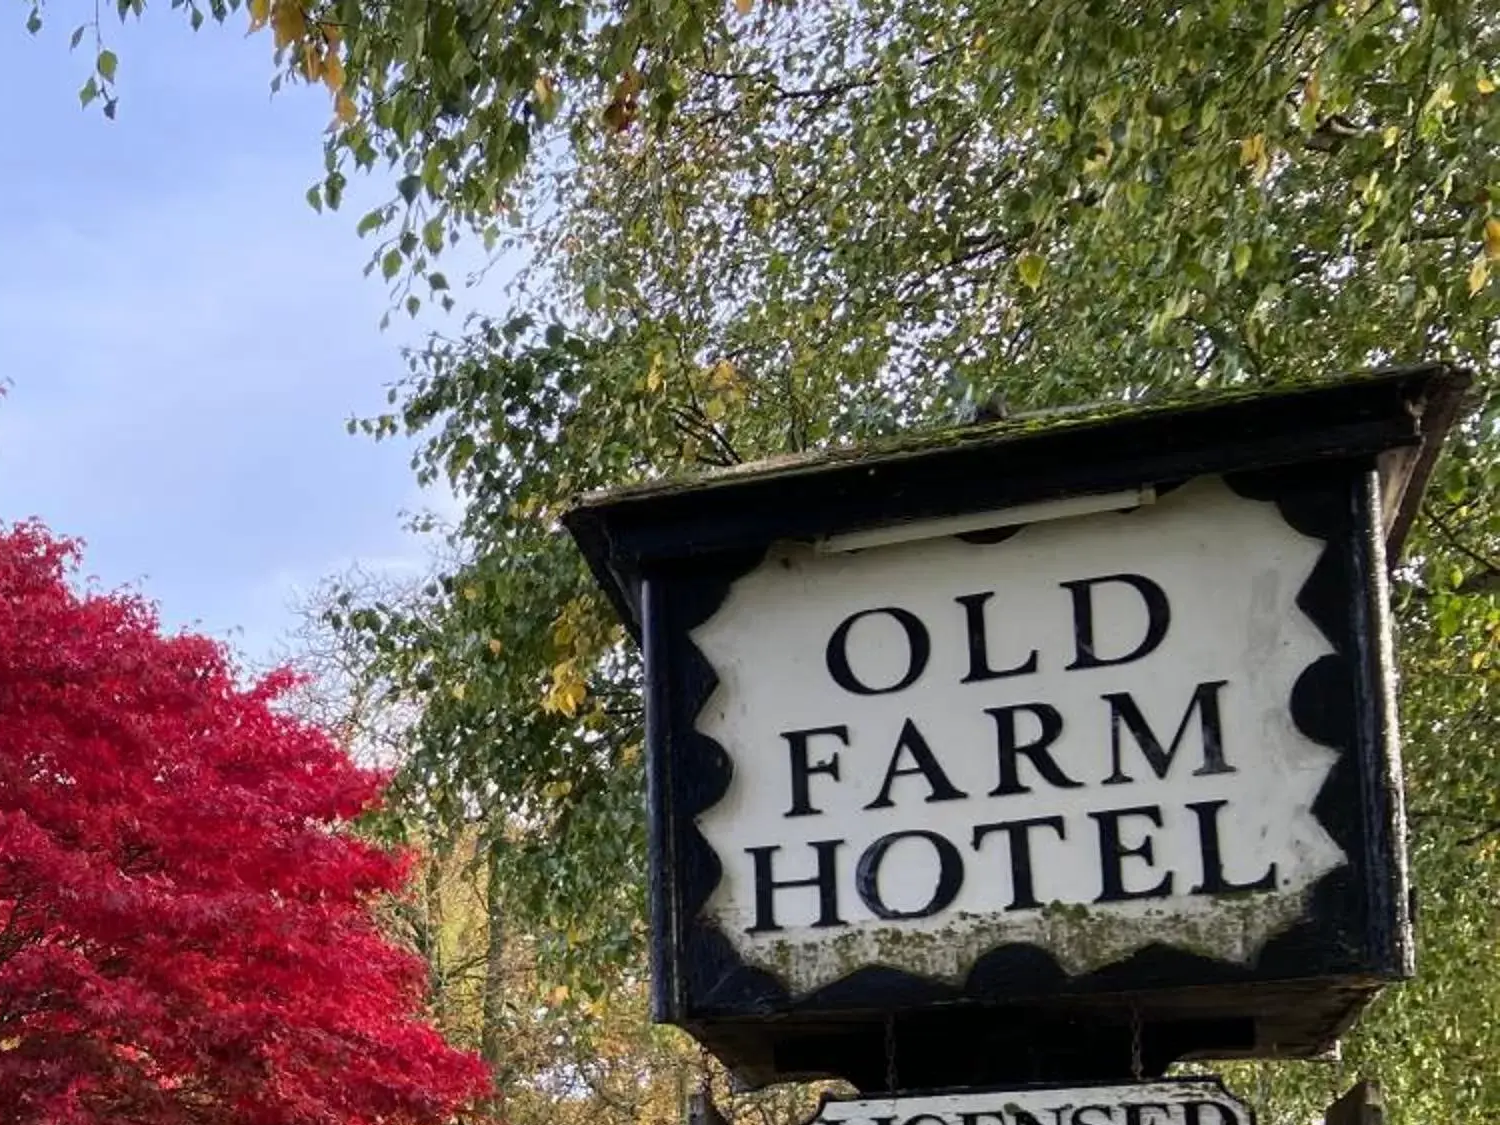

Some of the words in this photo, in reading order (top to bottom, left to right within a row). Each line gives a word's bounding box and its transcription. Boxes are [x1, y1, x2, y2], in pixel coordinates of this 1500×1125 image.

[825, 573, 1172, 696] OLD
[780, 680, 1238, 818] FARM
[744, 800, 1278, 936] HOTEL
